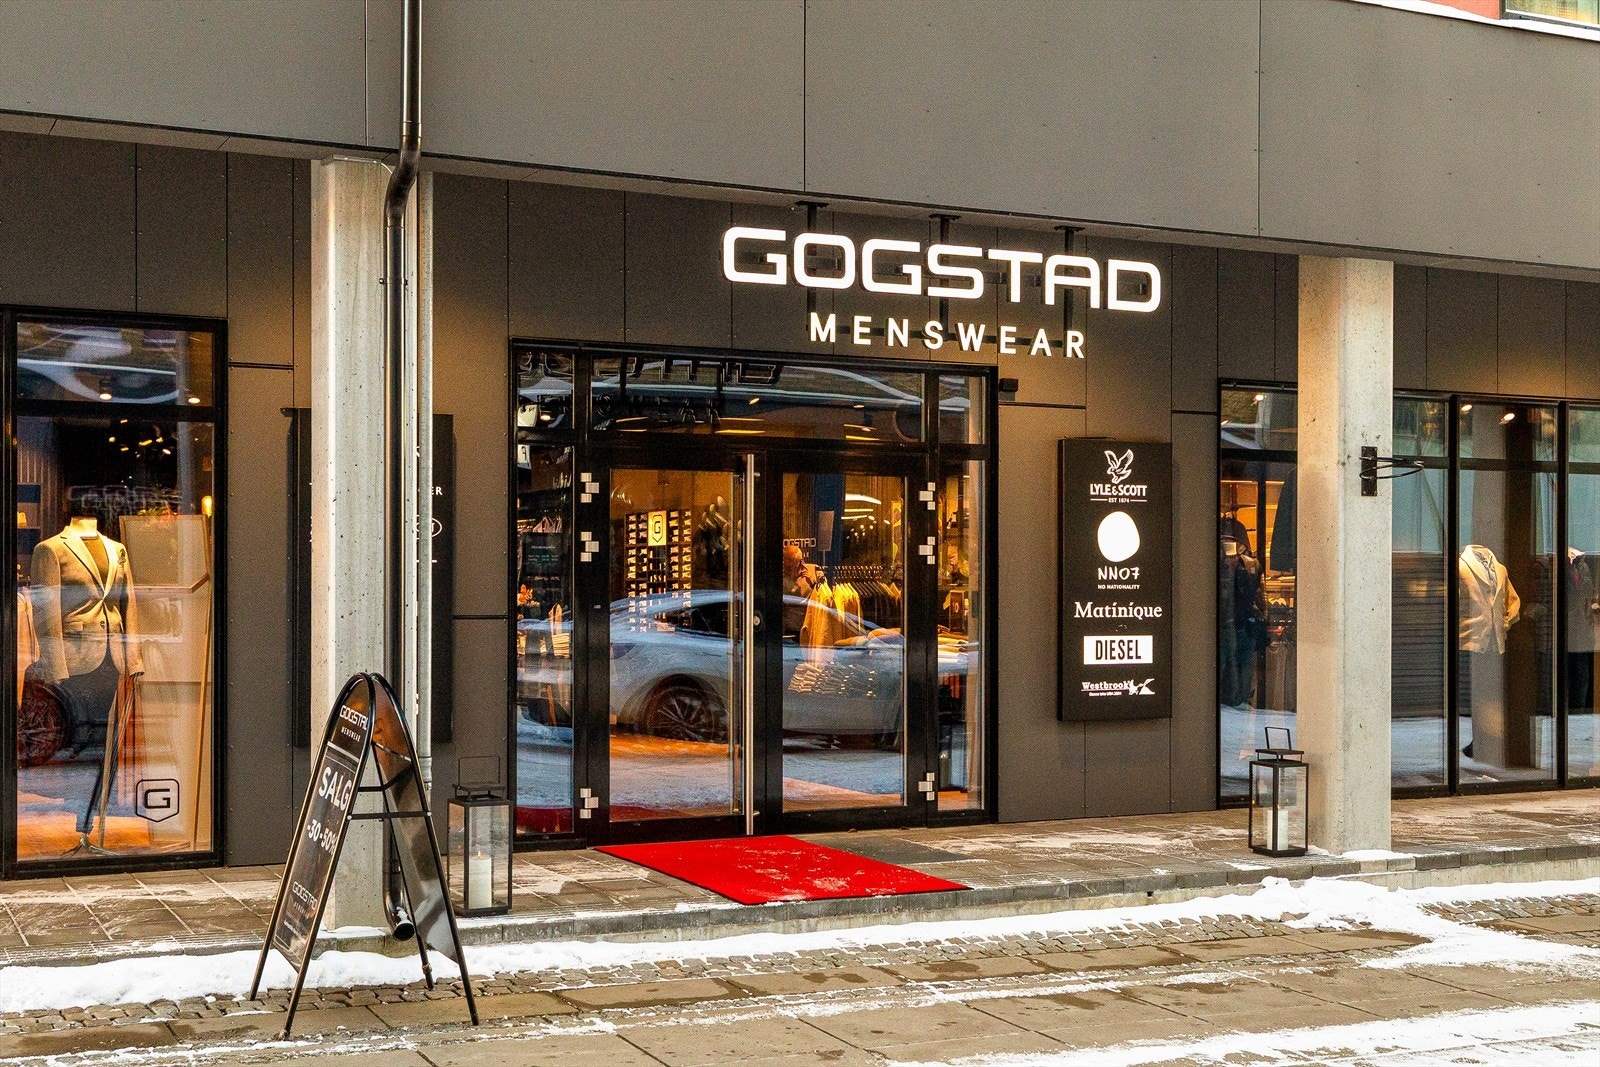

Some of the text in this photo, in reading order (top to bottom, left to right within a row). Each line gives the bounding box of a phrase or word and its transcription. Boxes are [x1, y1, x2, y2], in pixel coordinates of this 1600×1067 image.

[723, 226, 1161, 313] GOGSTAD
[809, 312, 1086, 359] MENSWEAR
[783, 537, 817, 548] OGSTAD
[1073, 601, 1163, 620] Matinique
[1095, 639, 1142, 660] DIESEL
[144, 789, 171, 809] G
[318, 766, 352, 811] SALG
